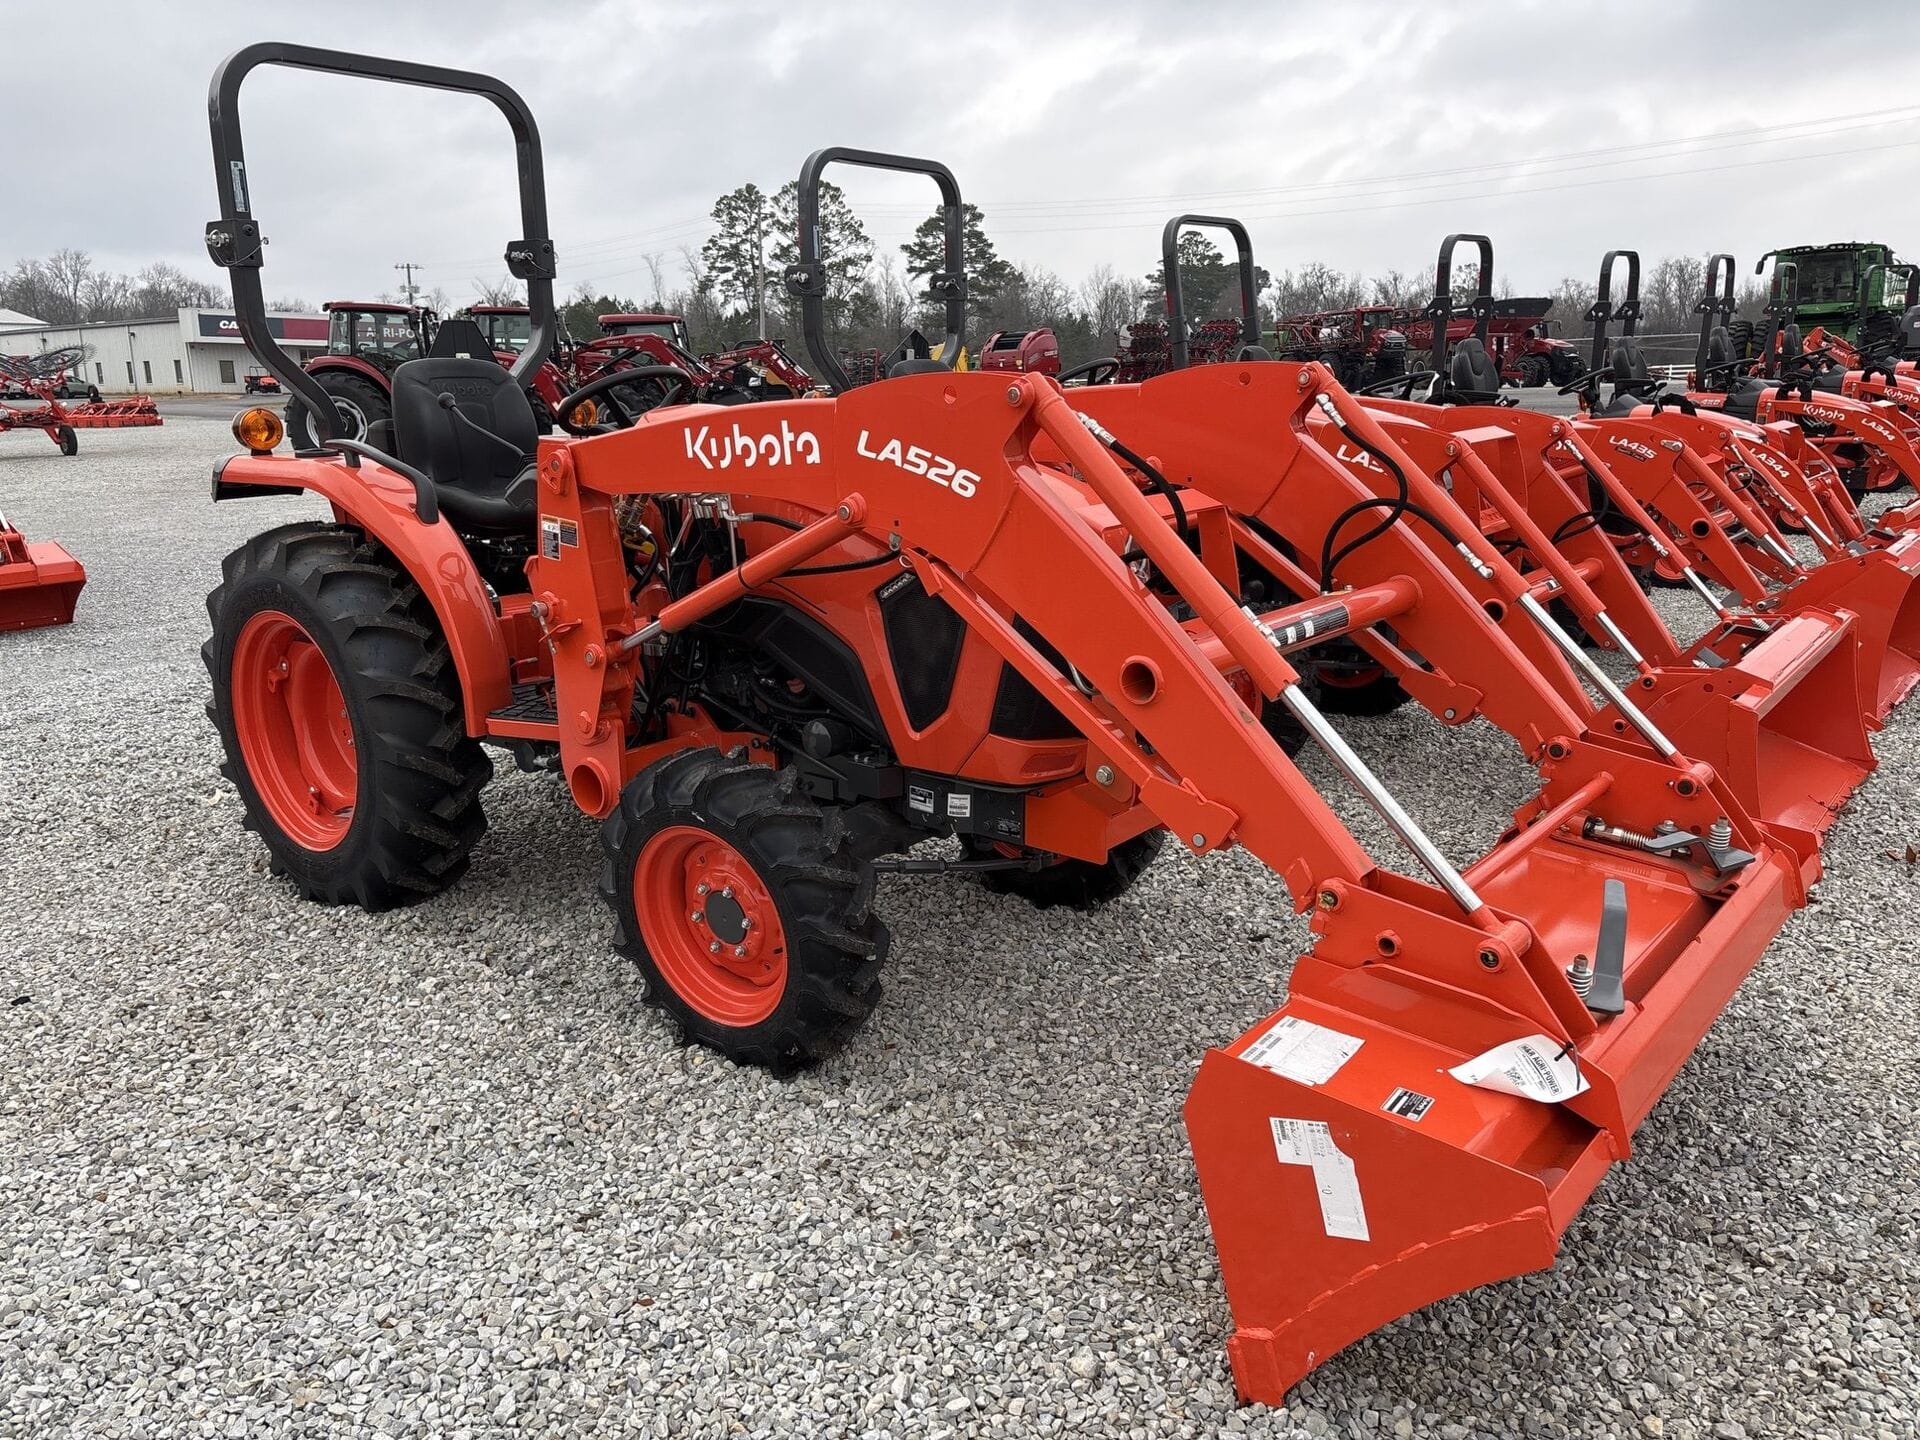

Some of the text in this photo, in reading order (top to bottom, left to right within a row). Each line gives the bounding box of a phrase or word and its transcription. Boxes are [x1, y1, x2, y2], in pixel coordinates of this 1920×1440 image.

[1883, 387, 1920, 404] Kubota
[1803, 404, 1846, 421] Kubota
[1861, 418, 1896, 441] LA344
[684, 420, 821, 470] Kubota
[1609, 435, 1657, 459] LA435
[857, 429, 982, 498] LA526
[1749, 447, 1790, 478] LA344
